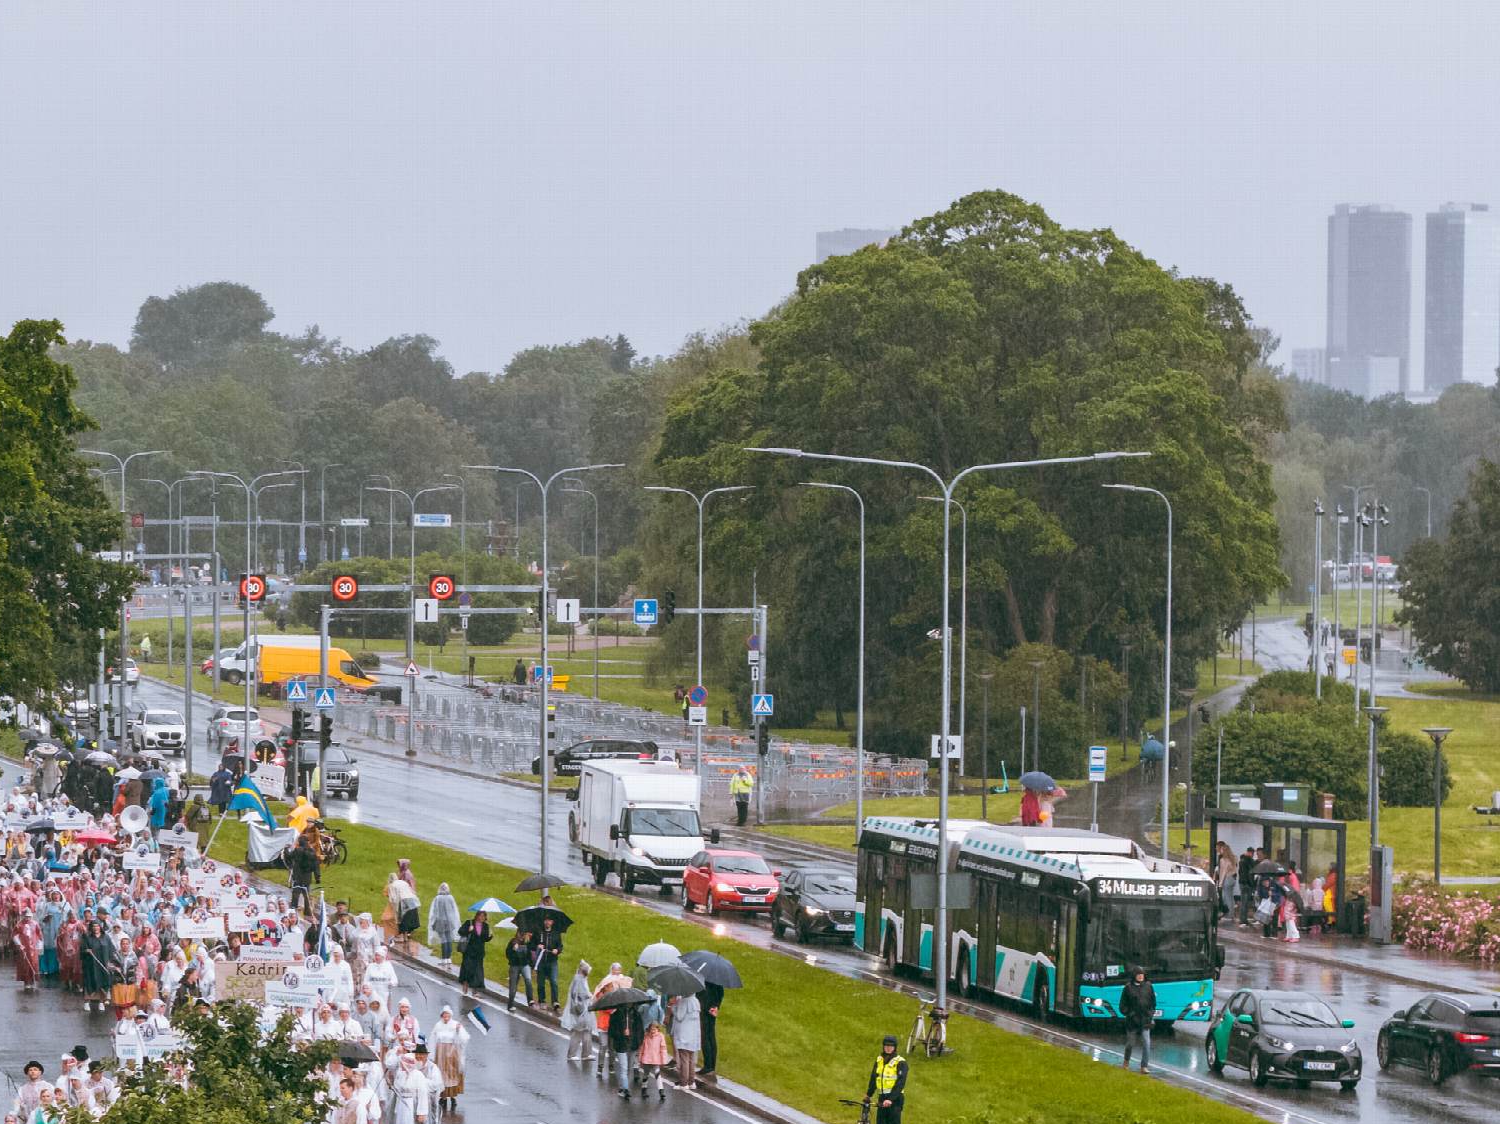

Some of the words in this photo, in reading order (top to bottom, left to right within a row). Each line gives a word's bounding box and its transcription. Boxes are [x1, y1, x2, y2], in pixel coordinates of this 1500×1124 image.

[339, 583, 352, 593] 30
[436, 583, 449, 593] 30
[1100, 880, 1111, 894] 34
[1113, 880, 1155, 896] Muuga
[1158, 882, 1202, 897] aedlinn
